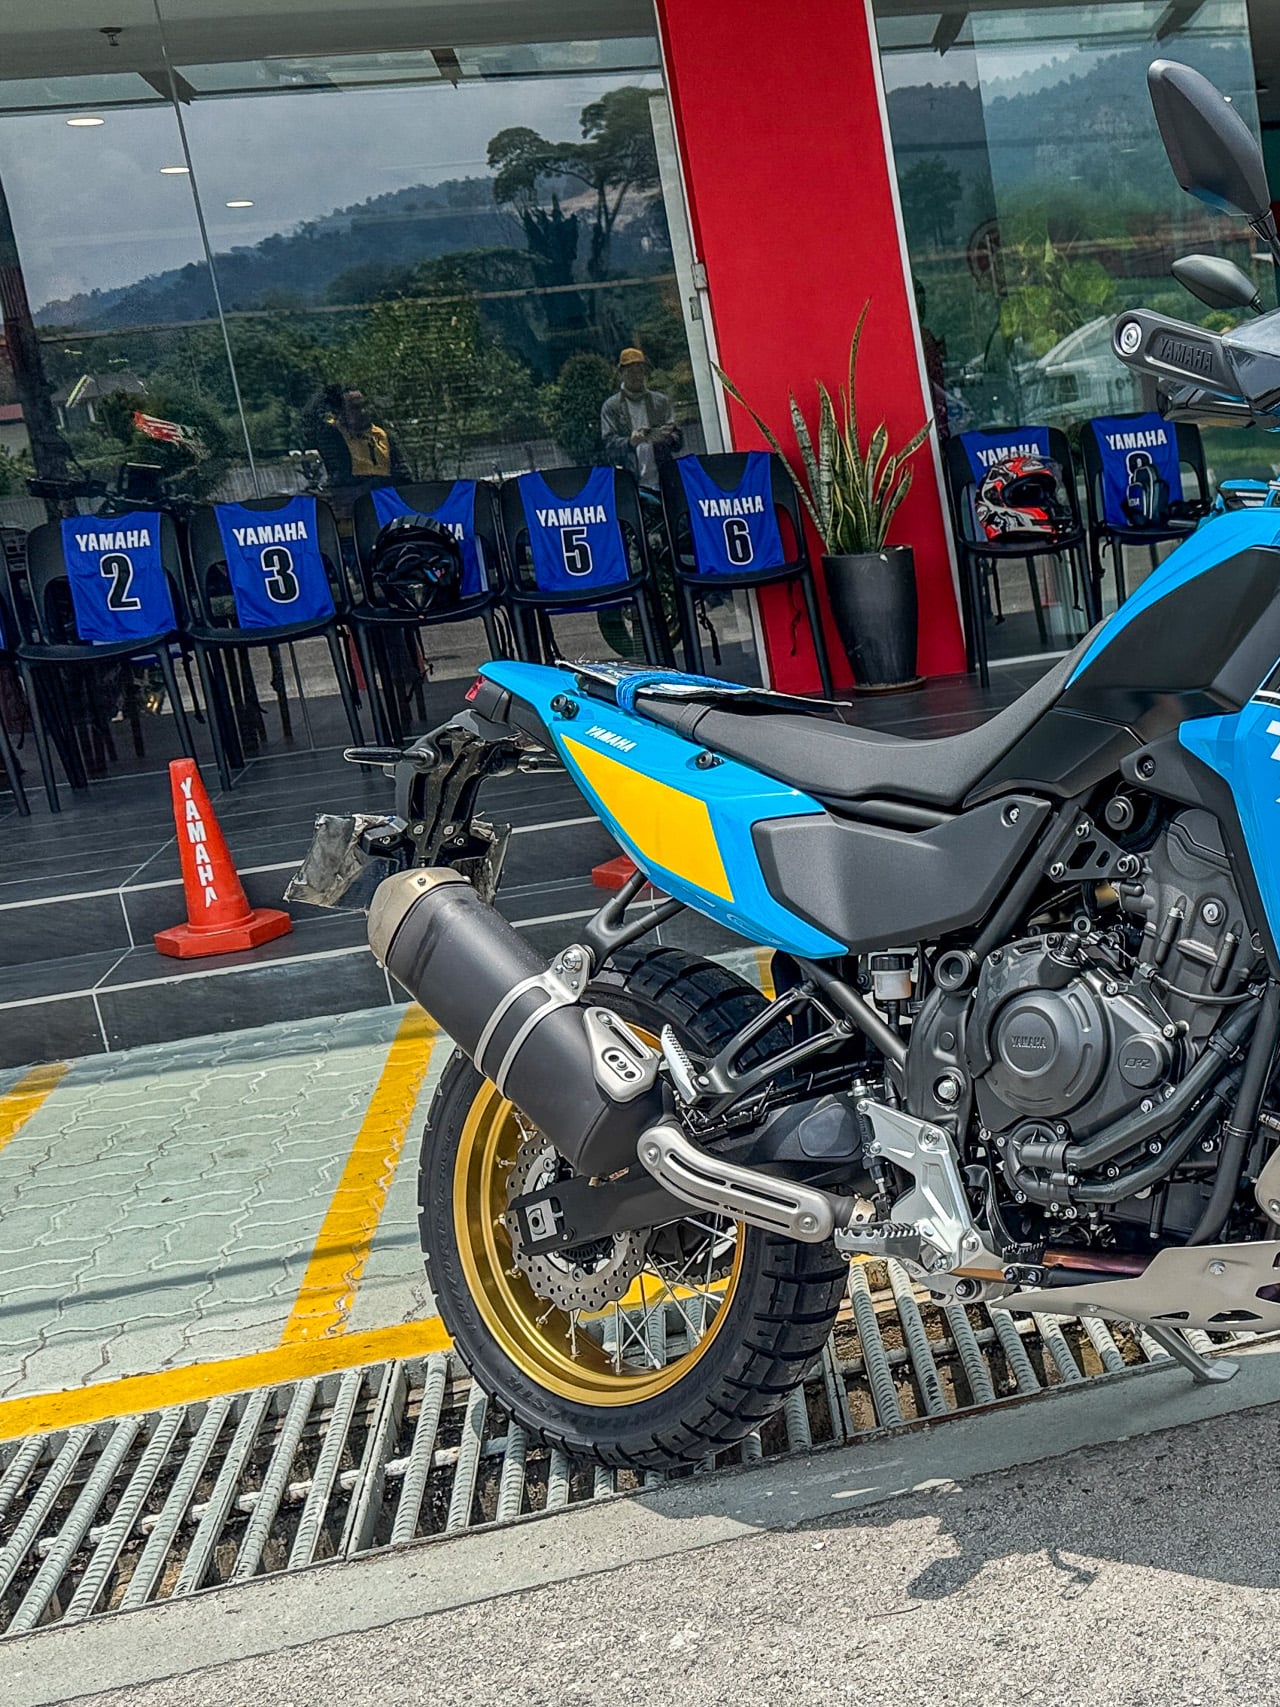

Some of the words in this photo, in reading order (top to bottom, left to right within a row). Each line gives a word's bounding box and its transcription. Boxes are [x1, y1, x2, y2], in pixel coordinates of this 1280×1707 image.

[1159, 337, 1214, 373] YAMAHA
[1105, 428, 1168, 451] YAMAHA
[976, 442, 1041, 468] YAMAHA
[536, 504, 607, 528] YAMAHA
[699, 495, 765, 518] YAMAHA
[75, 528, 151, 552] YAMAHA
[232, 520, 308, 547] YAMAHA
[722, 517, 754, 566] 6
[560, 526, 593, 577] 5
[100, 552, 142, 612] 2
[260, 545, 300, 604] 3
[584, 724, 637, 753] YAMAHA
[180, 776, 218, 908] YAMAHA
[1011, 1035, 1047, 1049] YAMAHA
